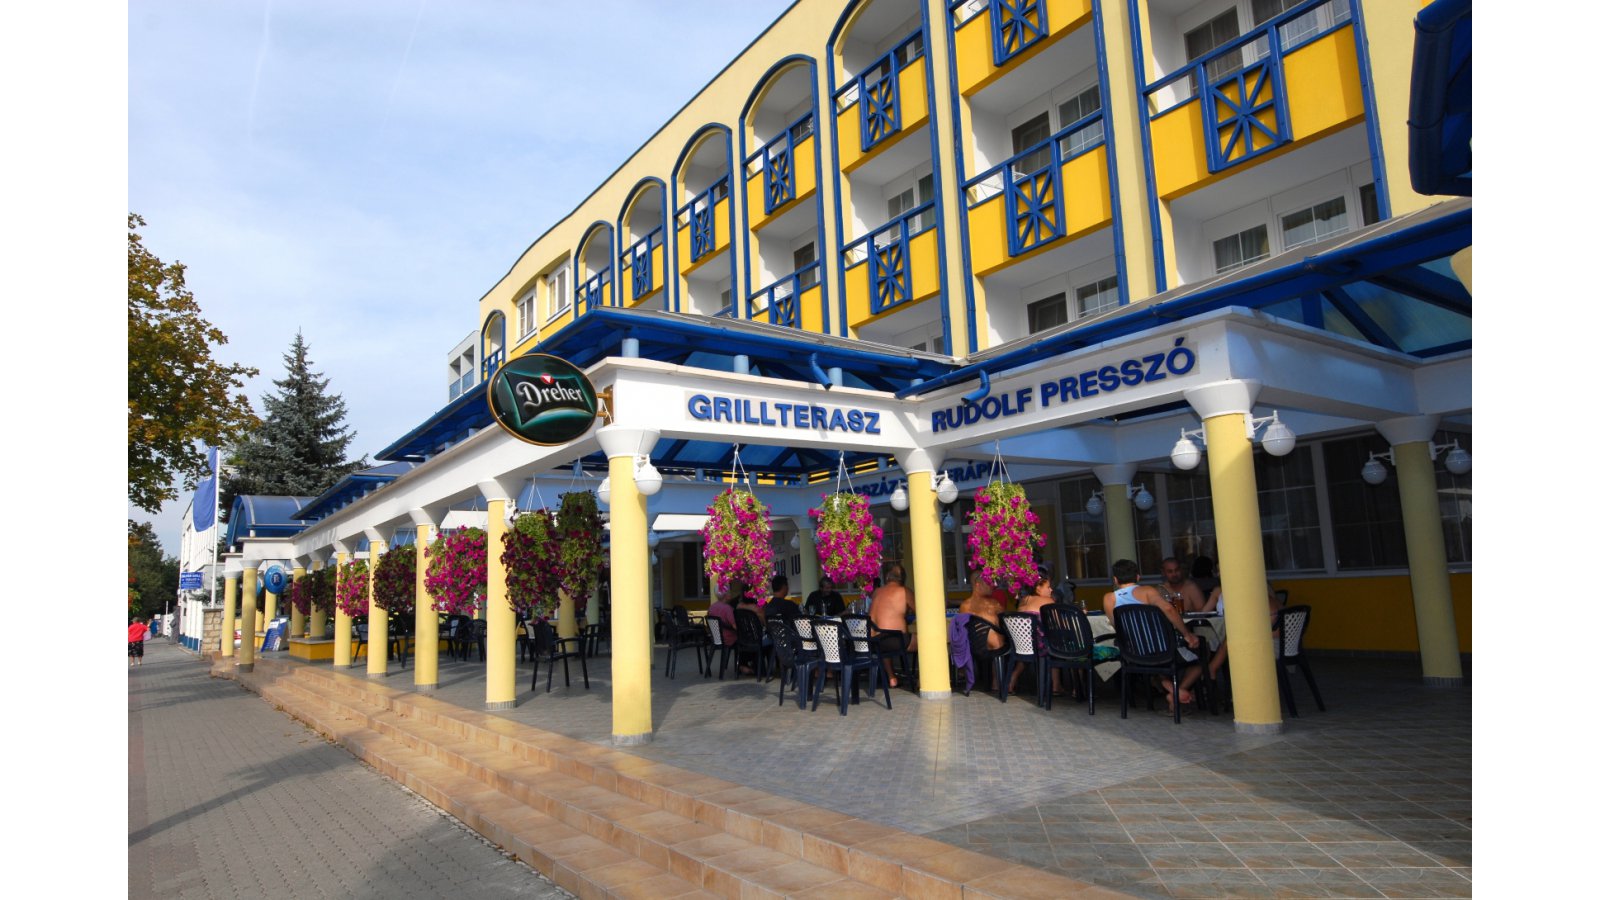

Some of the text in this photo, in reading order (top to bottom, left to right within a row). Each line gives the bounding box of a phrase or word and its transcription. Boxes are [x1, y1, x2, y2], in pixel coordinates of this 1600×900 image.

[516, 381, 584, 407] Dreher
[932, 337, 1196, 433] RUDOLF PRESSZÓ
[688, 394, 881, 433] GRILLTERASZ
